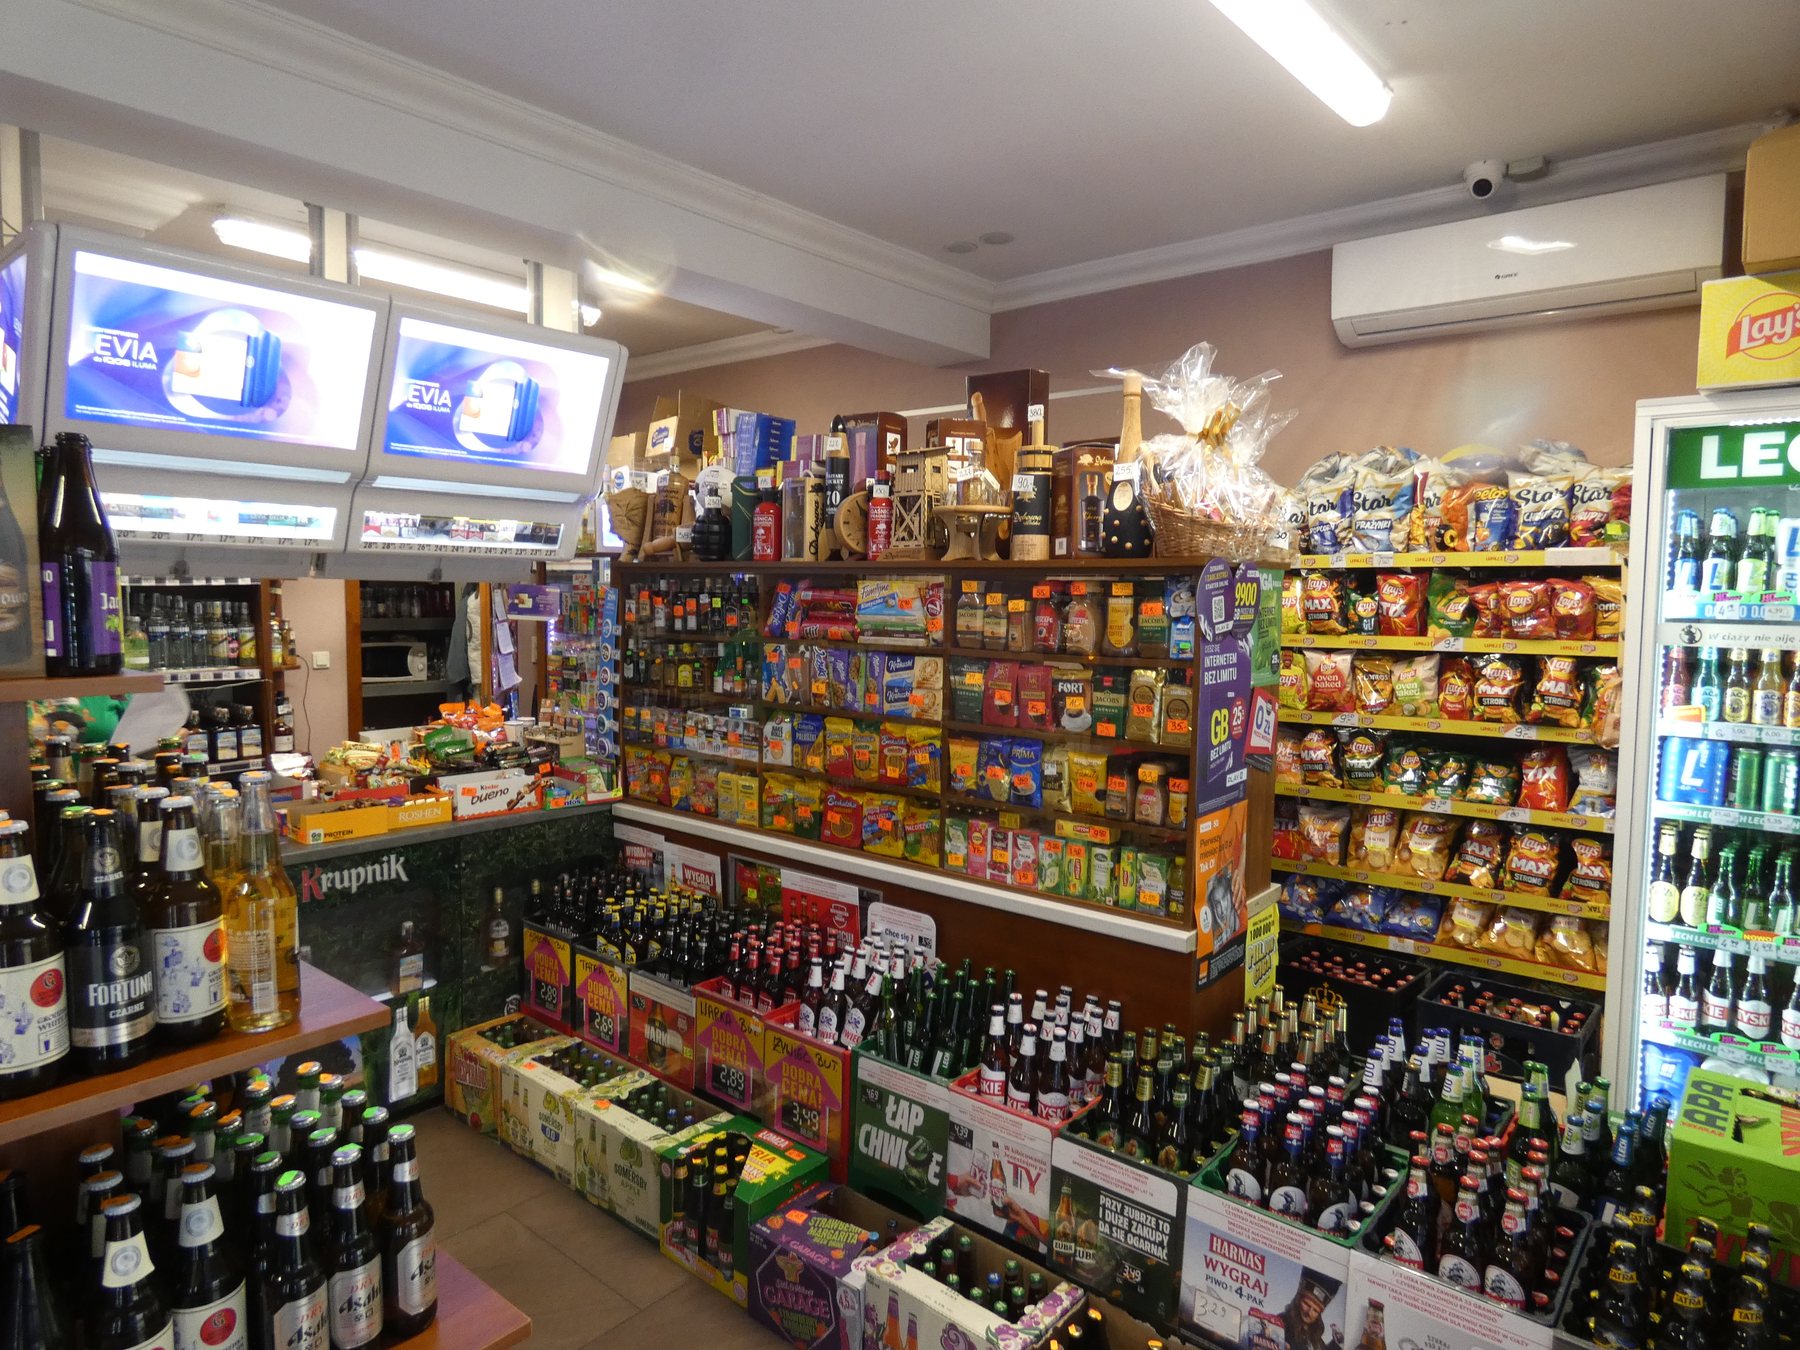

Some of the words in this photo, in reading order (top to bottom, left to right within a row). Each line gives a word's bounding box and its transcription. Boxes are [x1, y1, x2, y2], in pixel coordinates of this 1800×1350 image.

[1355, 491, 1392, 512] Star
[1473, 488, 1508, 501] eetos
[1516, 487, 1564, 506] Star
[1235, 583, 1258, 607] 9900
[1305, 597, 1332, 610] MAX
[1140, 616, 1166, 625] JACOBS
[1204, 653, 1238, 668] INTERNETEM
[1204, 671, 1216, 685] BEZ
[1217, 668, 1237, 683] LIMITU
[1279, 675, 1297, 687] ay's
[1314, 680, 1342, 689] baked
[1316, 674, 1339, 682] oven
[1396, 683, 1418, 691] oven
[1094, 695, 1120, 704] JACOBS
[1210, 708, 1229, 746] GB
[1011, 747, 1036, 760] PRIMA
[1210, 748, 1219, 762] BEZ
[399, 806, 442, 822] ROSHEN
[324, 828, 354, 839] PROTEIN
[1510, 856, 1550, 875] MAX
[94, 870, 124, 884] CZARNE
[301, 853, 409, 902] Krupnik
[684, 866, 714, 887] WYGRAJ
[1514, 872, 1543, 885] STRONG
[1570, 877, 1600, 889] STRONG
[534, 951, 560, 972] DOBRA
[534, 963, 560, 987] CENA!
[587, 979, 615, 998] DOBRA
[109, 1002, 145, 1019] CZARNE
[587, 993, 615, 1017] CENA!
[711, 1026, 747, 1046] DOBRA
[711, 1043, 748, 1069] CENA!
[942, 1052, 950, 1069] LECH
[782, 1062, 821, 1088] DOBRA
[782, 1079, 823, 1106] CENA!
[885, 1094, 925, 1136] ŁAP
[1564, 1128, 1575, 1150] LECH
[1617, 1137, 1627, 1159] LECH
[614, 1162, 648, 1190] SOMERSBY
[1099, 1194, 1121, 1212] PRZY
[1123, 1203, 1157, 1227] ŻUBRZE
[1158, 1218, 1170, 1235] TO
[807, 1227, 858, 1244] MARGARITA
[1104, 1207, 1130, 1230] DUŻE
[1131, 1219, 1169, 1246] ZAKUPY
[1099, 1219, 1110, 1235] DA
[1112, 1226, 1126, 1243] SIĘ
[1127, 1232, 1169, 1261] OGARNĄĆ
[789, 1240, 830, 1265] GARAGE
[1204, 1254, 1268, 1298] WYGRAJ
[1205, 1274, 1228, 1290] PIWO
[1234, 1285, 1265, 1308] 4-PAK
[763, 1286, 831, 1319] GARAGE
